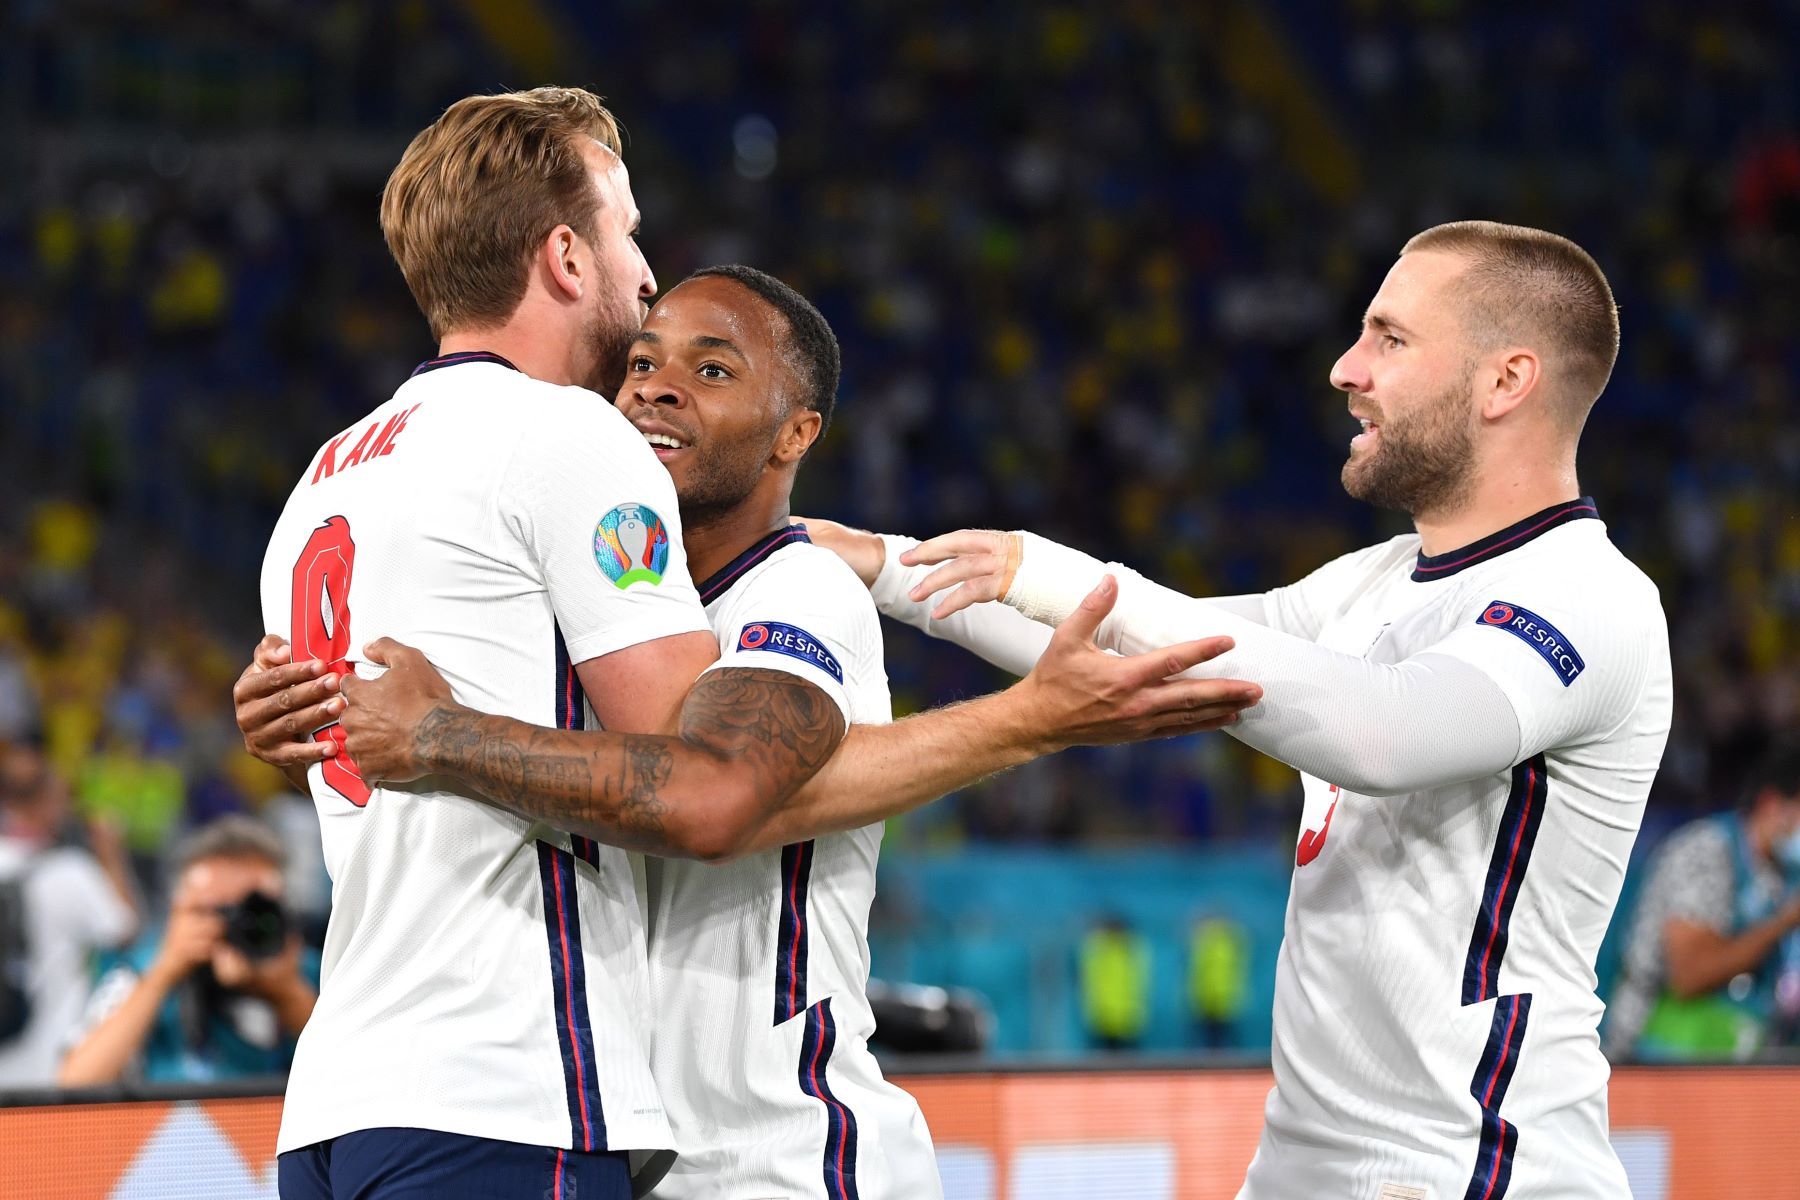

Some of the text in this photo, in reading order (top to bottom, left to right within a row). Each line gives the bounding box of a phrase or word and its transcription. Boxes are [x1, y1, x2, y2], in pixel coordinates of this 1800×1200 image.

[311, 402, 423, 486] KANE
[770, 631, 842, 677] RESPECT
[1511, 615, 1579, 677] RESPECT
